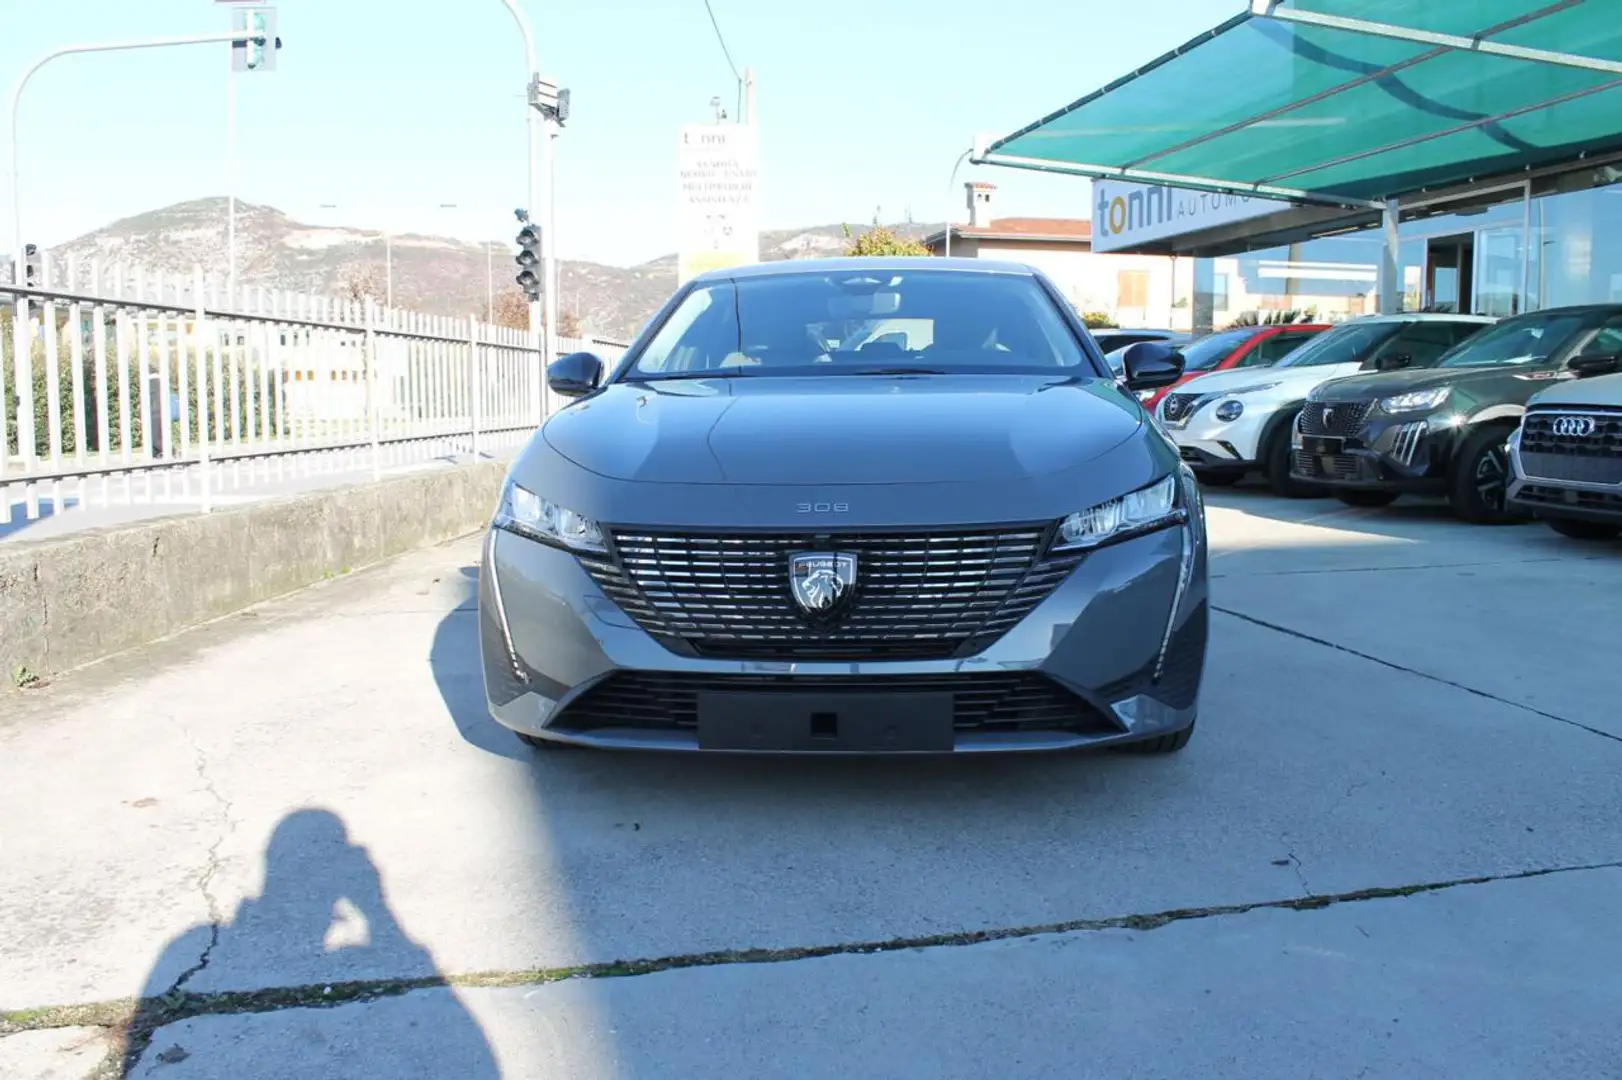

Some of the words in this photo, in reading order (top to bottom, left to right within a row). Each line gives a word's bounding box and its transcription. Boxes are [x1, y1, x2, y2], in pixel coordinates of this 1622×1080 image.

[683, 131, 726, 145] tnni
[1097, 186, 1172, 237] tonni
[796, 502, 849, 513] 308
